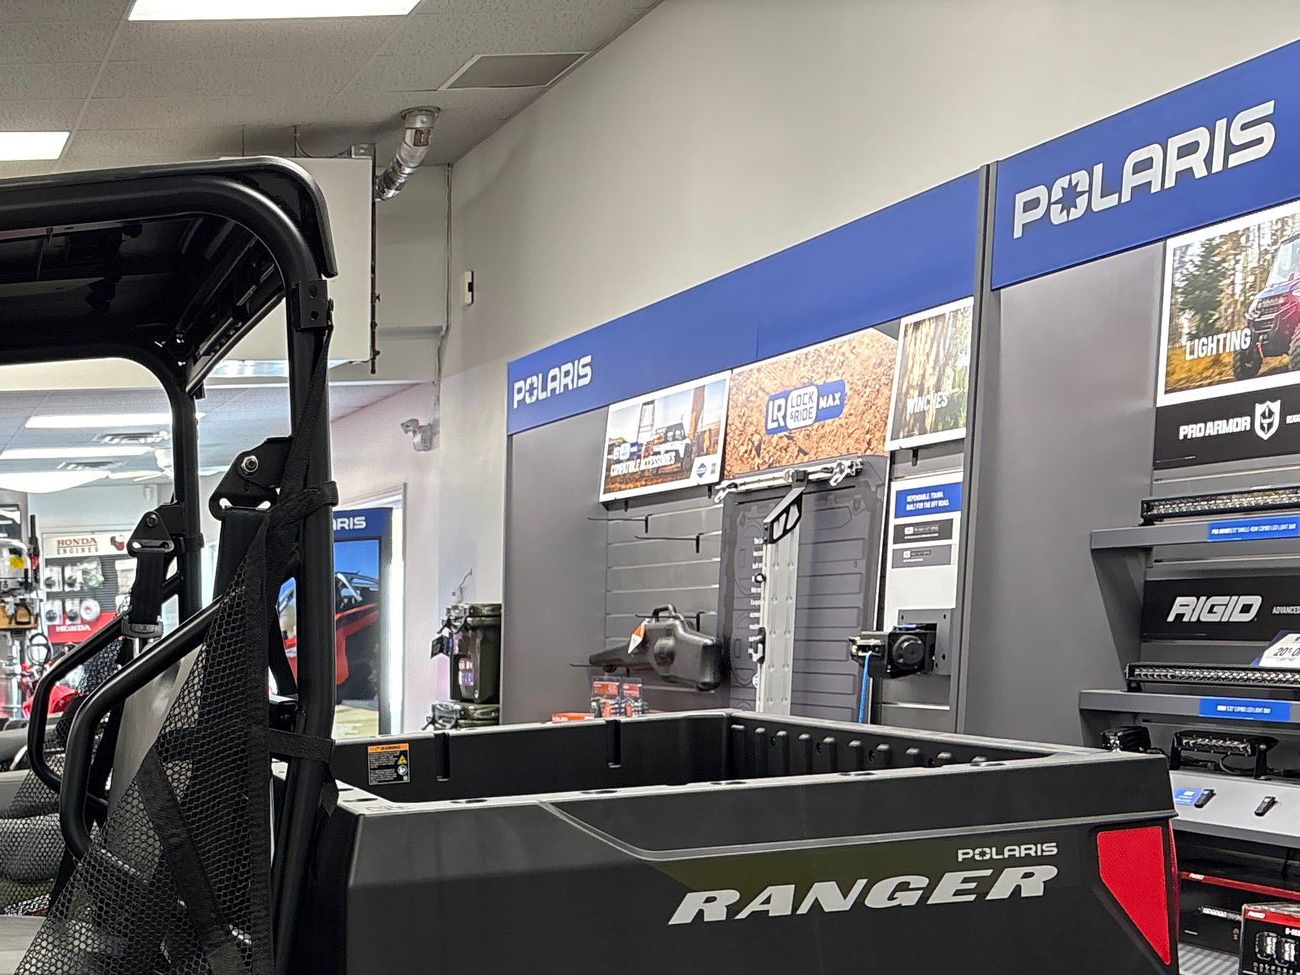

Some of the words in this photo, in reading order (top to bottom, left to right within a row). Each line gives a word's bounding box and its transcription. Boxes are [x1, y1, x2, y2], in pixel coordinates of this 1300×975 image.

[1012, 99, 1276, 240] POLARIS
[1185, 328, 1252, 361] LIGHTING
[513, 354, 592, 409] POLARIS
[790, 391, 815, 409] LOCK
[818, 392, 842, 410] MAX
[906, 391, 949, 415] WINCHES
[56, 538, 98, 547] HONDA
[57, 547, 99, 555] ENGINES
[1167, 596, 1262, 622] RIGID
[56, 625, 91, 633] HONDA
[957, 843, 1058, 862] POLARIS
[668, 865, 1058, 925] RANGER
